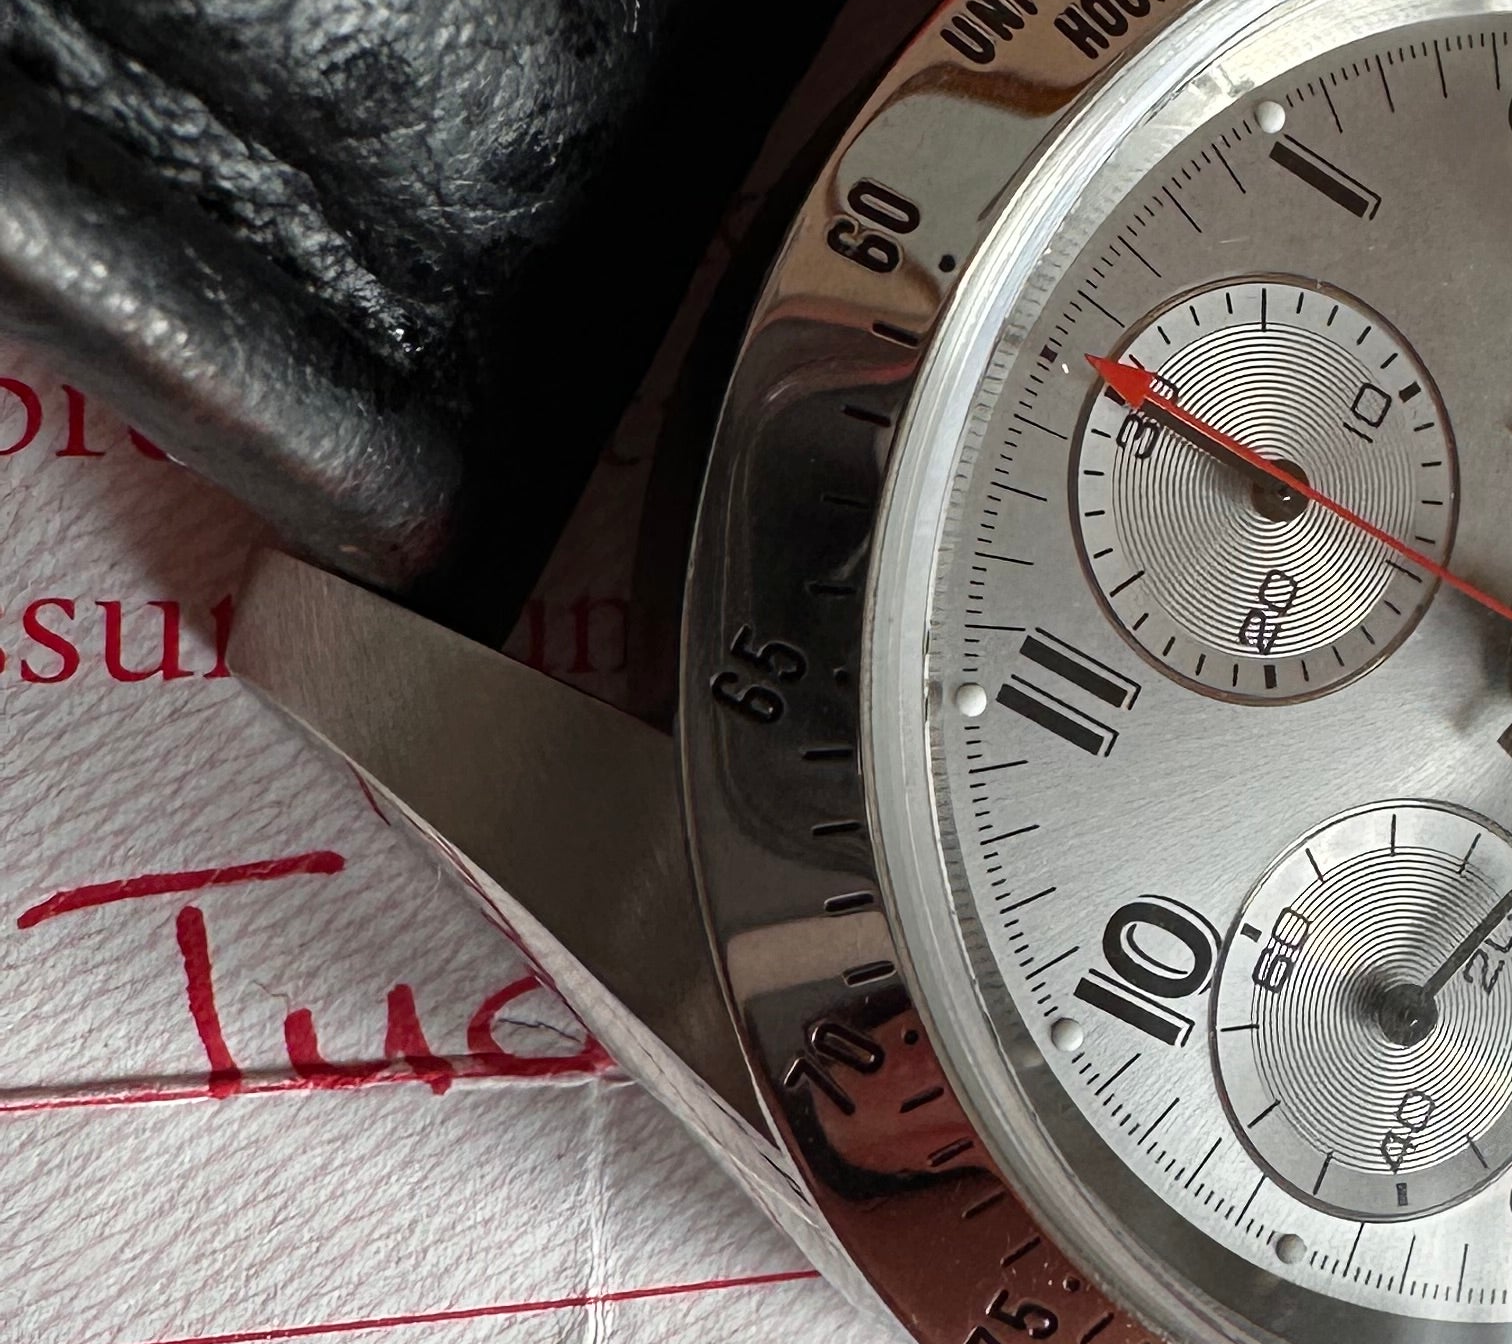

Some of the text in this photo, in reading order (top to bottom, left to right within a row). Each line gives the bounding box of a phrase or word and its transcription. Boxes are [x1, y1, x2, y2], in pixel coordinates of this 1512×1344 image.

[826, 179, 921, 275] 60
[1343, 382, 1392, 443] 10
[710, 625, 807, 724] 65
[1074, 893, 1221, 1047] 10
[783, 1020, 885, 1115] 70
